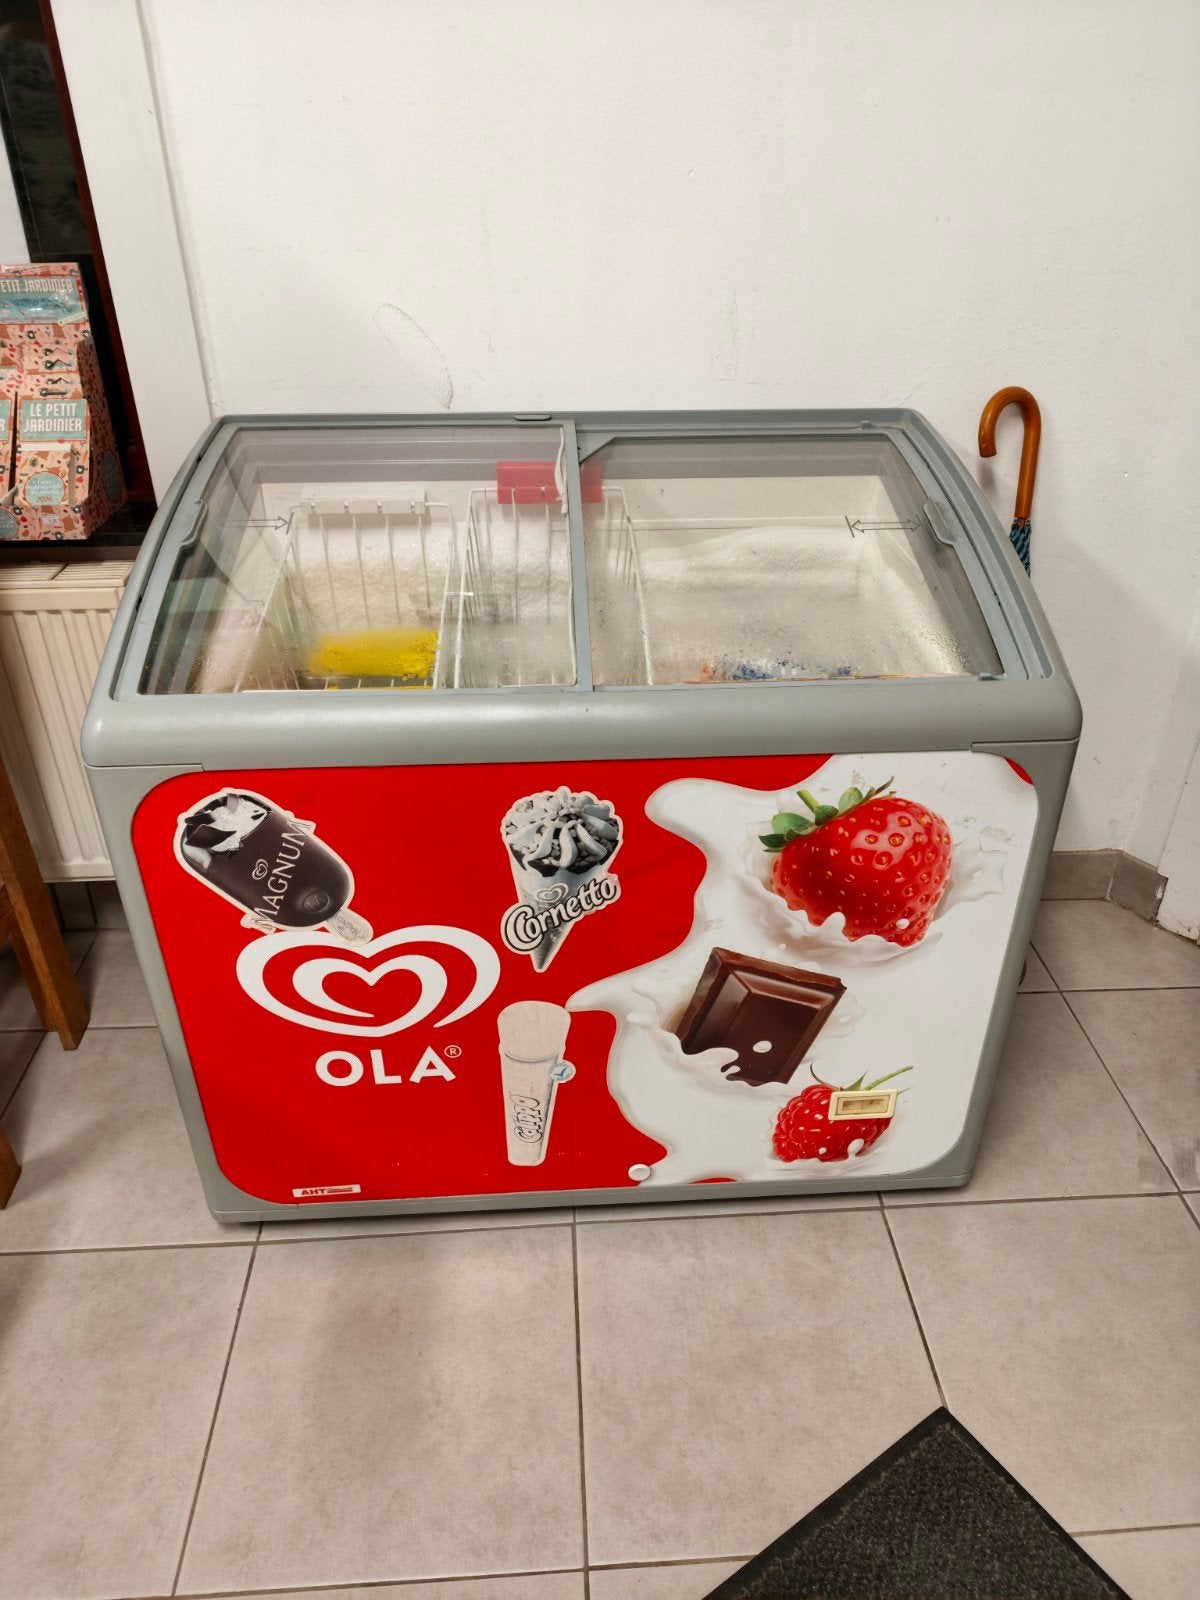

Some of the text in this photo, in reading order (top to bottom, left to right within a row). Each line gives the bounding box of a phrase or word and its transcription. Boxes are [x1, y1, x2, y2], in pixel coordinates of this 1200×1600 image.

[0, 279, 20, 293] ETIT
[30, 402, 78, 417] LE PETIT
[23, 418, 82, 432] JARDINIER
[248, 818, 312, 932] MAGNUM
[504, 877, 618, 952] Cornetto
[301, 1188, 327, 1196] AHT
